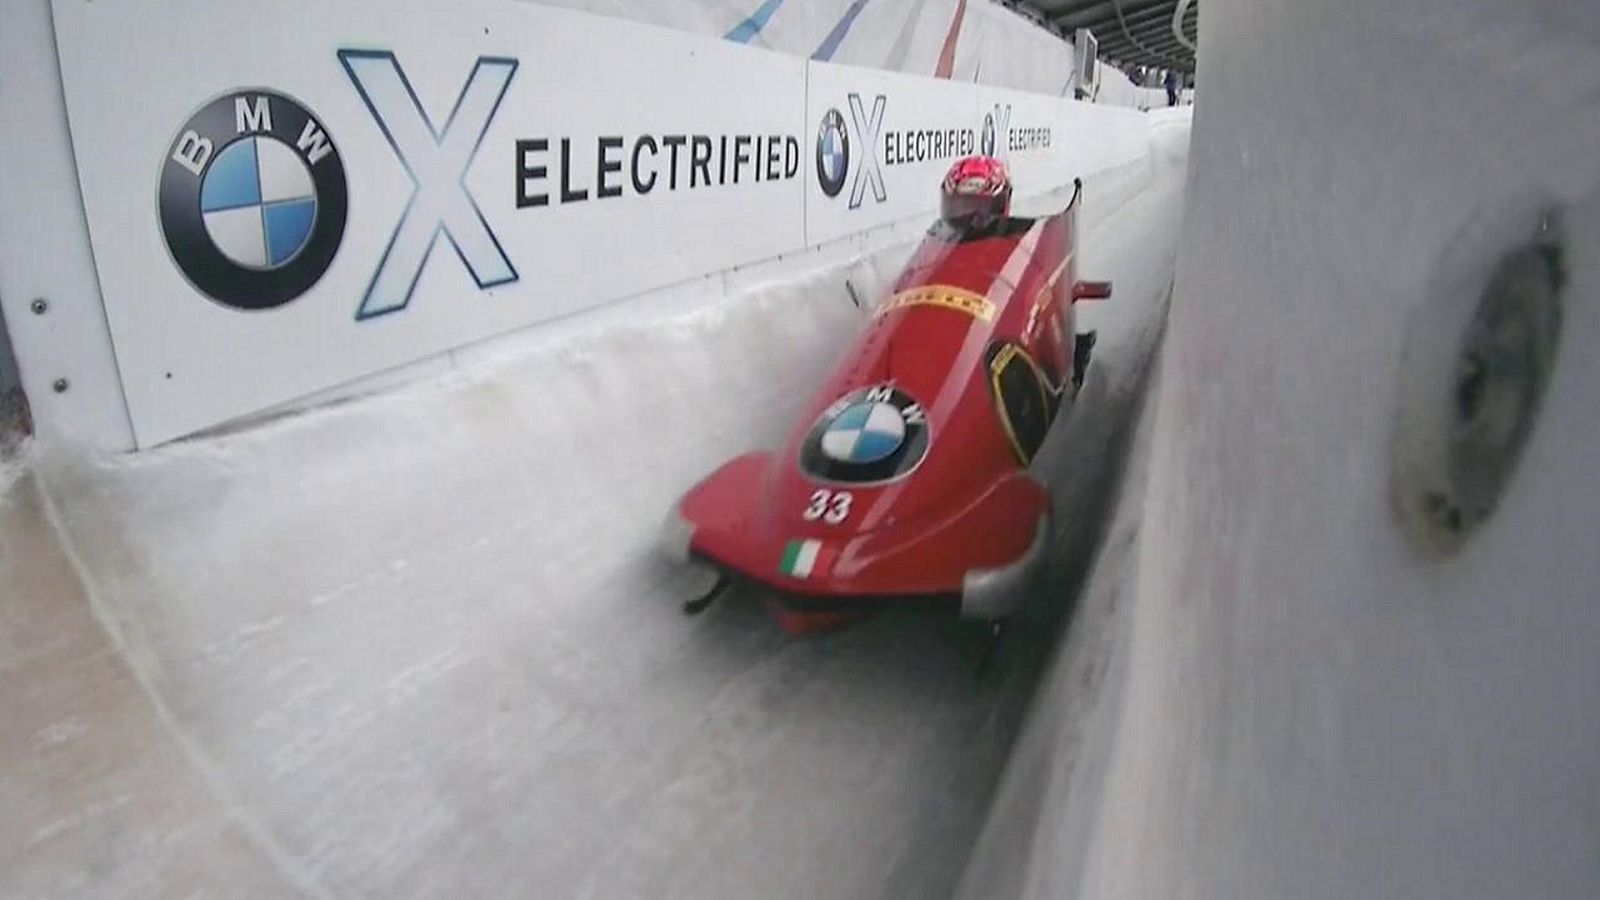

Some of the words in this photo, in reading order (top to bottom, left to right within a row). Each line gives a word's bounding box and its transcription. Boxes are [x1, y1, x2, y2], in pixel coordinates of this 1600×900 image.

[172, 96, 333, 176] BMW
[848, 93, 887, 209] X
[885, 129, 975, 165] ELECTRIFIED
[1008, 128, 1051, 151] ELECTRIFIED
[337, 48, 520, 322] X
[515, 134, 800, 210] ELECTRIFIED
[802, 488, 853, 525] 33
